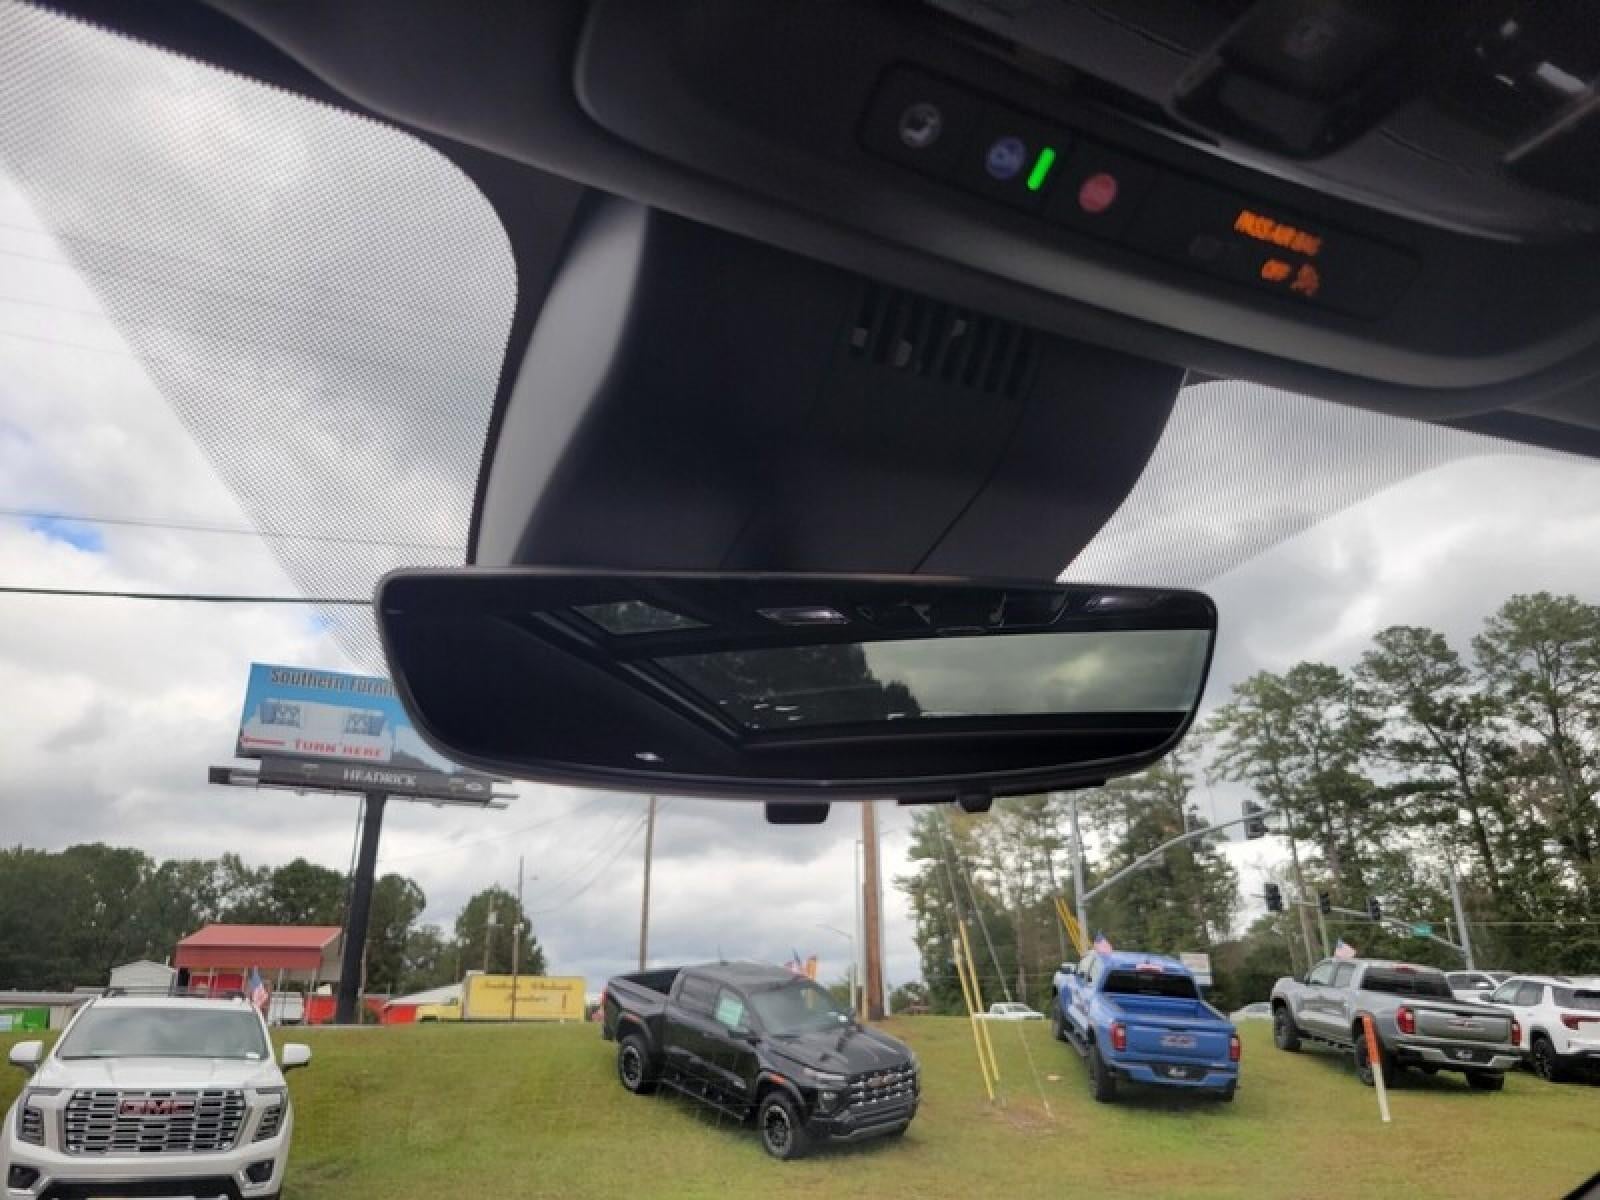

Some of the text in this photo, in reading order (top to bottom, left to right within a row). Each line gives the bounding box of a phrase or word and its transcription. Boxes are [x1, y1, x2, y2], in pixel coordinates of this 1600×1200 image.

[295, 738, 385, 758] TURN HERE
[343, 767, 417, 787] HEADRICK
